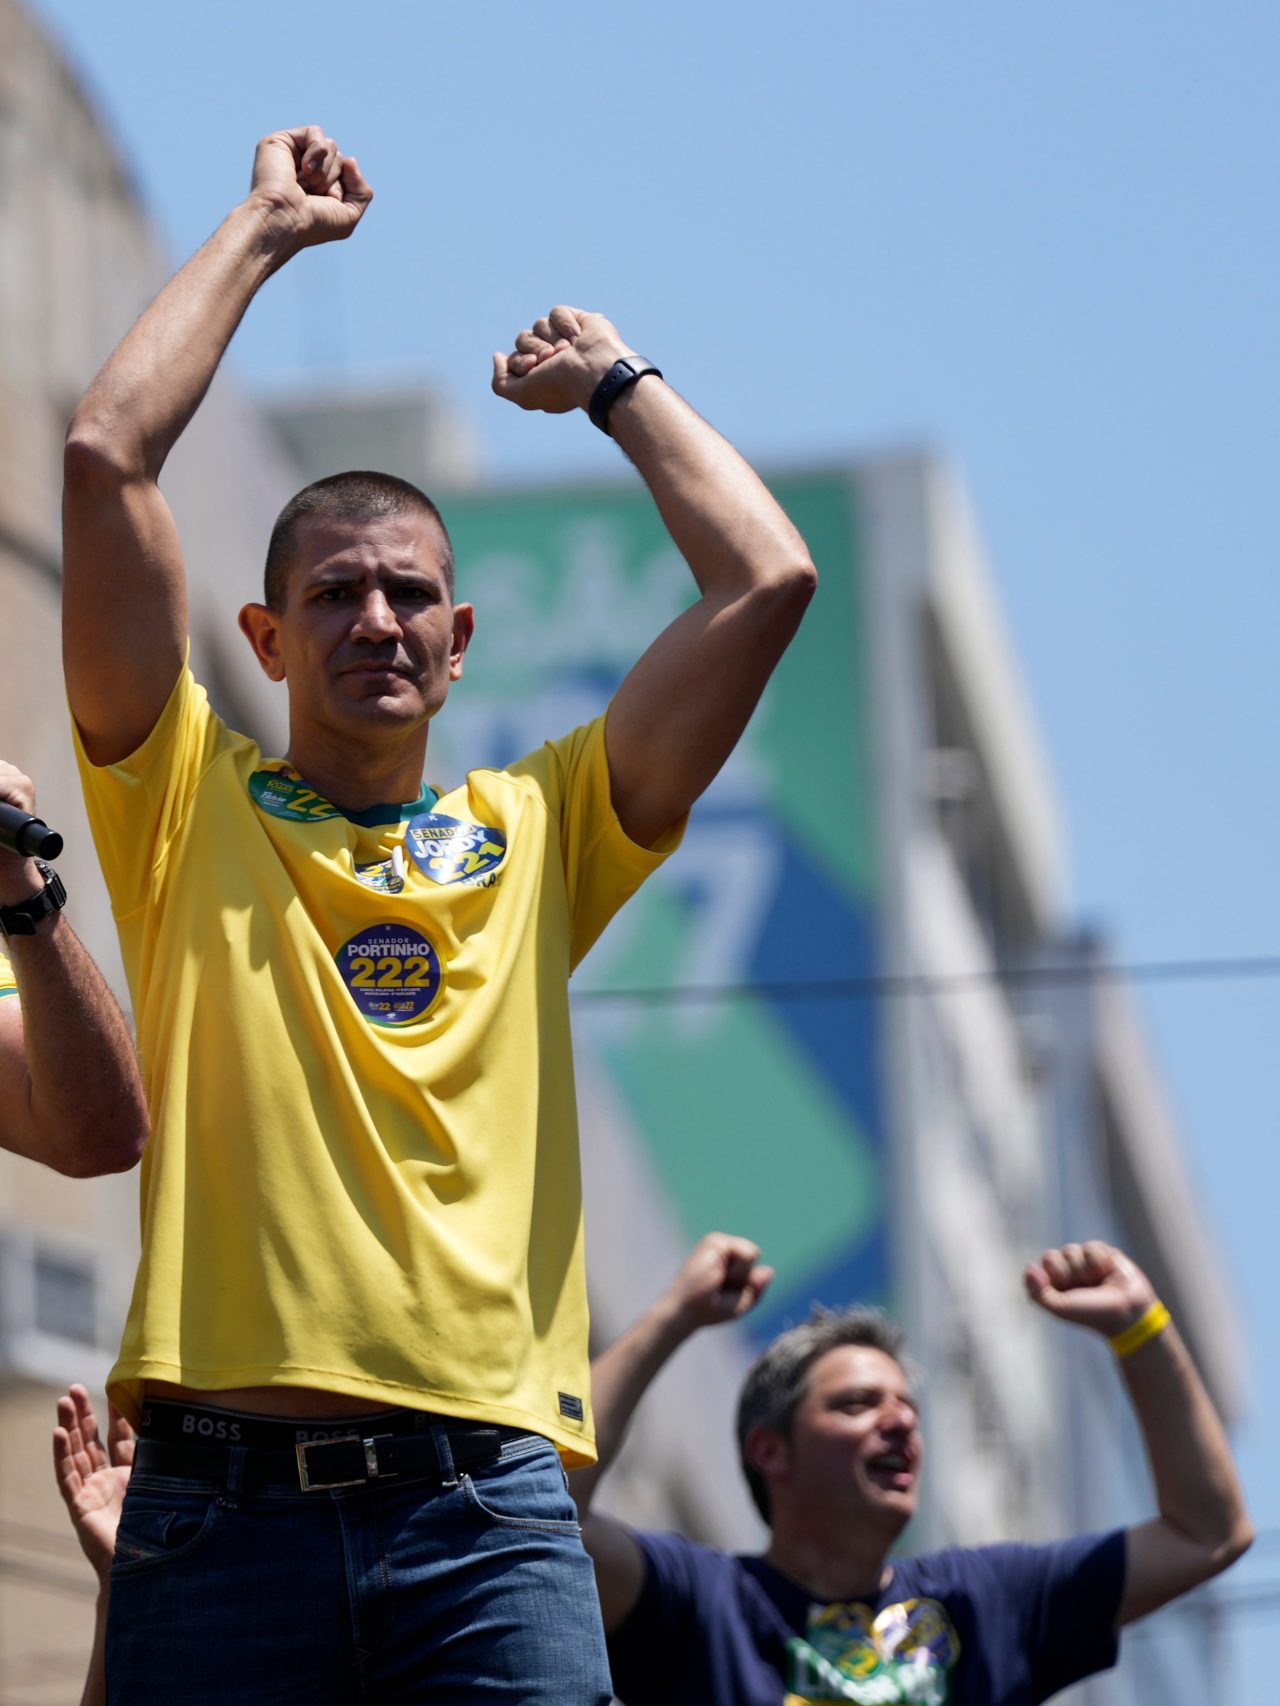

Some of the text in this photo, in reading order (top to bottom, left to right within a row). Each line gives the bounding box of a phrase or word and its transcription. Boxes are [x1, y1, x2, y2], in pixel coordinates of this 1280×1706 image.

[412, 824, 475, 839] SENAD
[429, 841, 505, 884] 221
[347, 943, 431, 957] PORTINHO
[367, 937, 410, 945] SENADOR
[349, 956, 431, 988] 222
[182, 1414, 242, 1441] BOSS
